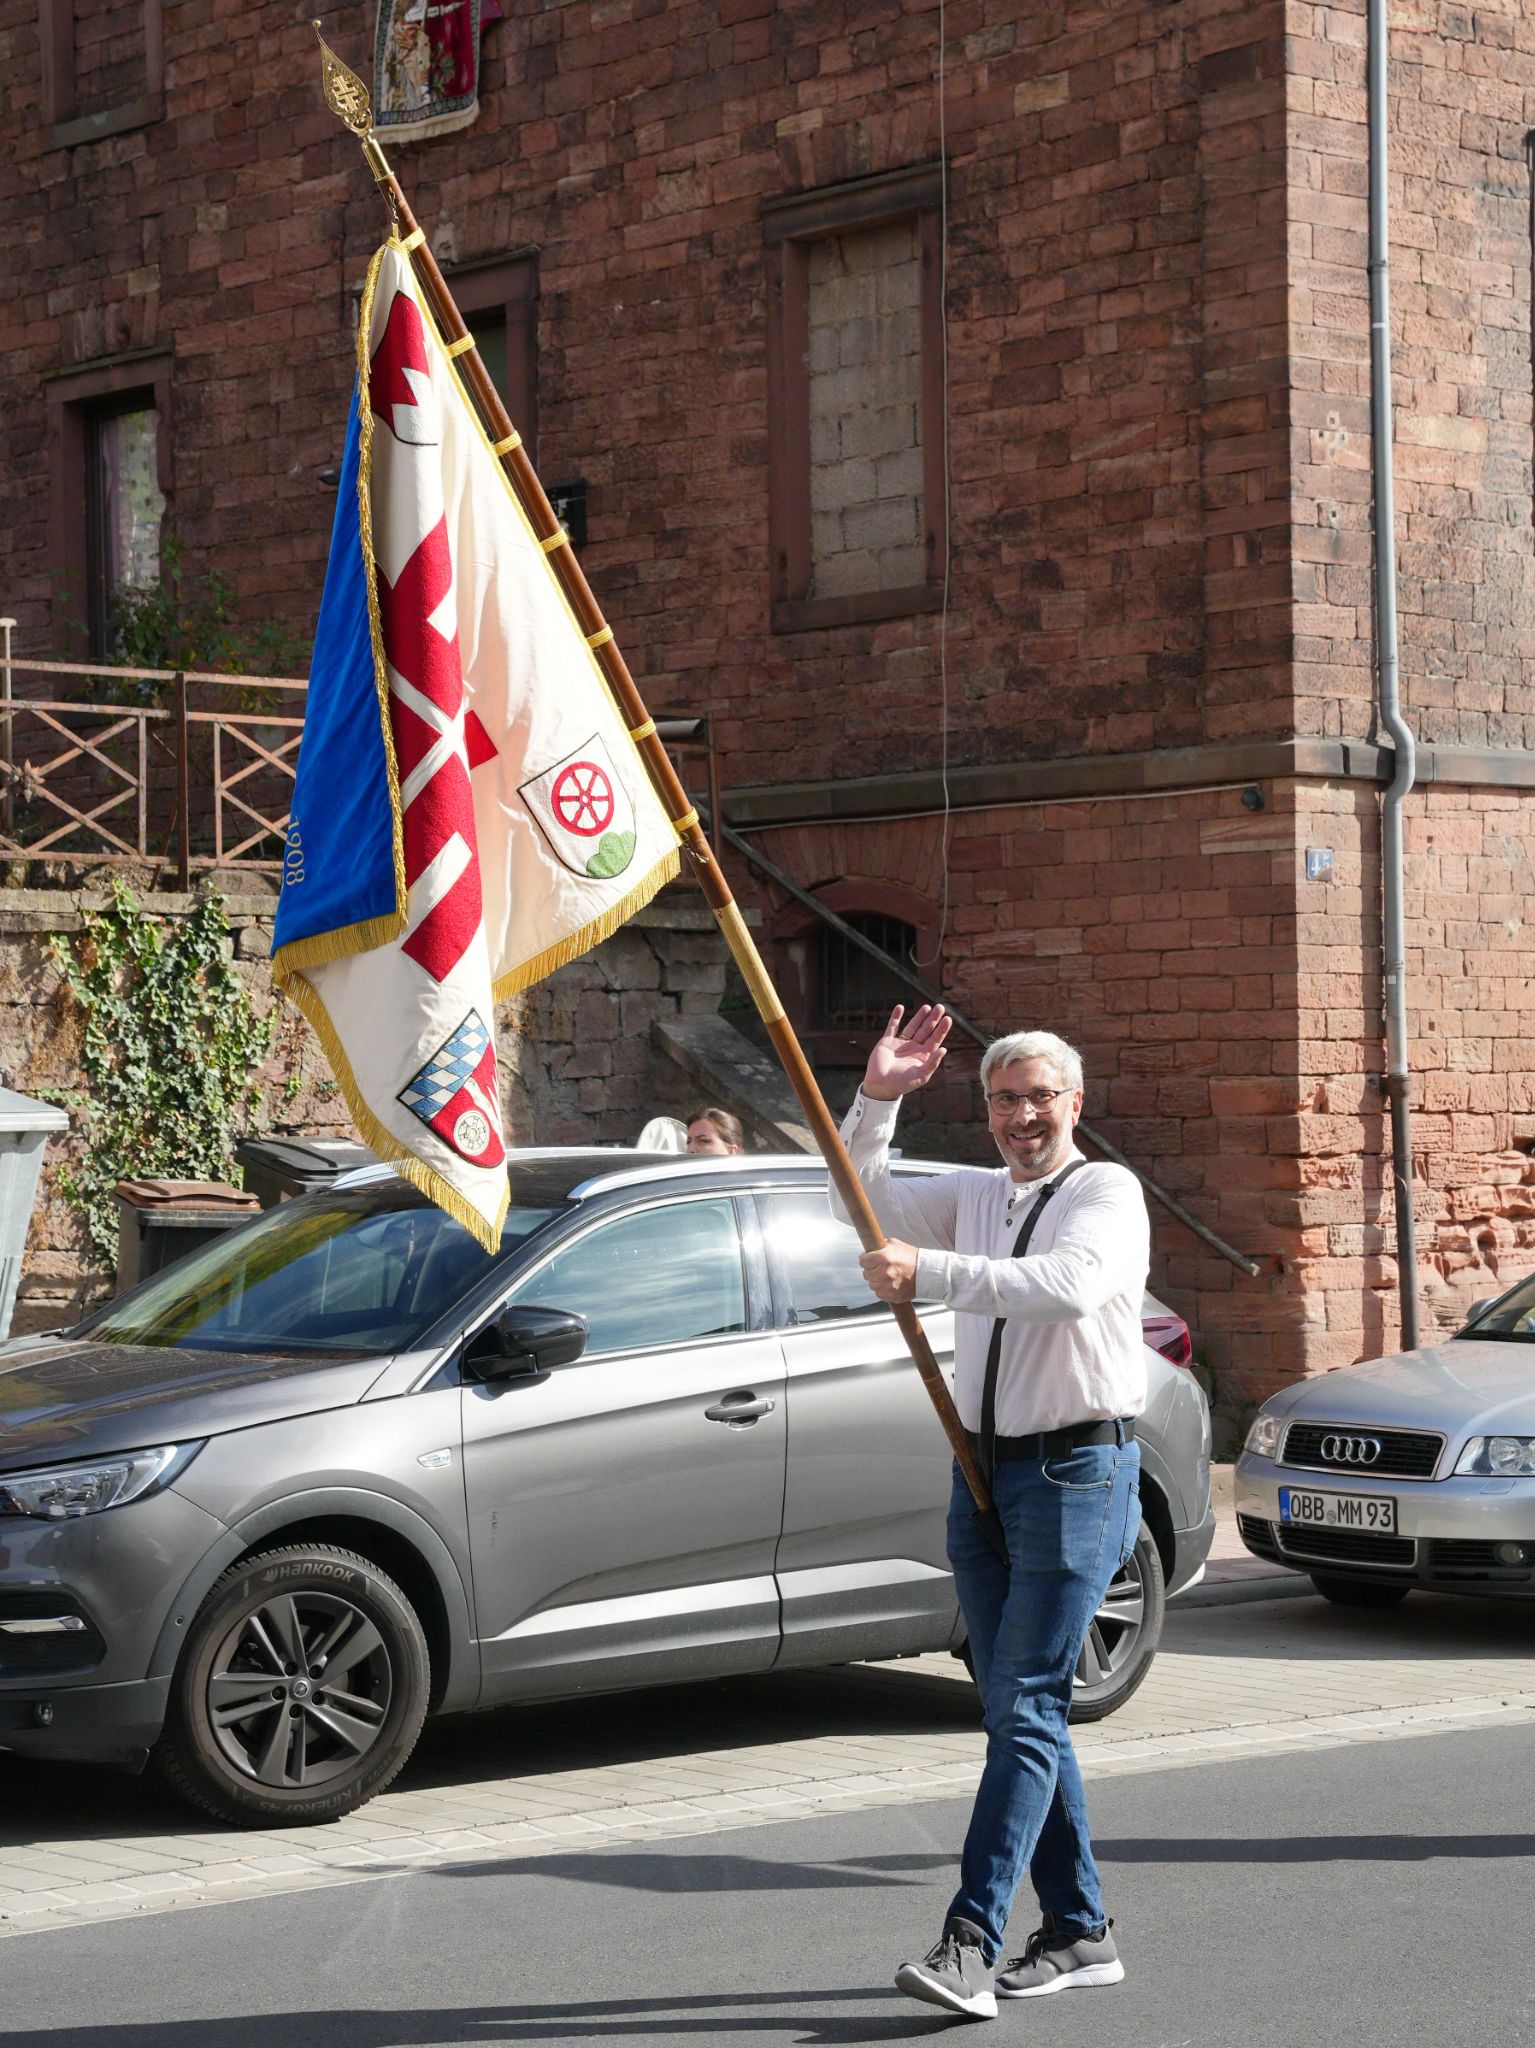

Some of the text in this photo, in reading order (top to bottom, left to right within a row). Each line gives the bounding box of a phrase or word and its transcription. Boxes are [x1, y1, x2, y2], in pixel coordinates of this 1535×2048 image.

[286, 815, 305, 886] 1908
[1291, 1494, 1392, 1528] OBB MM 93
